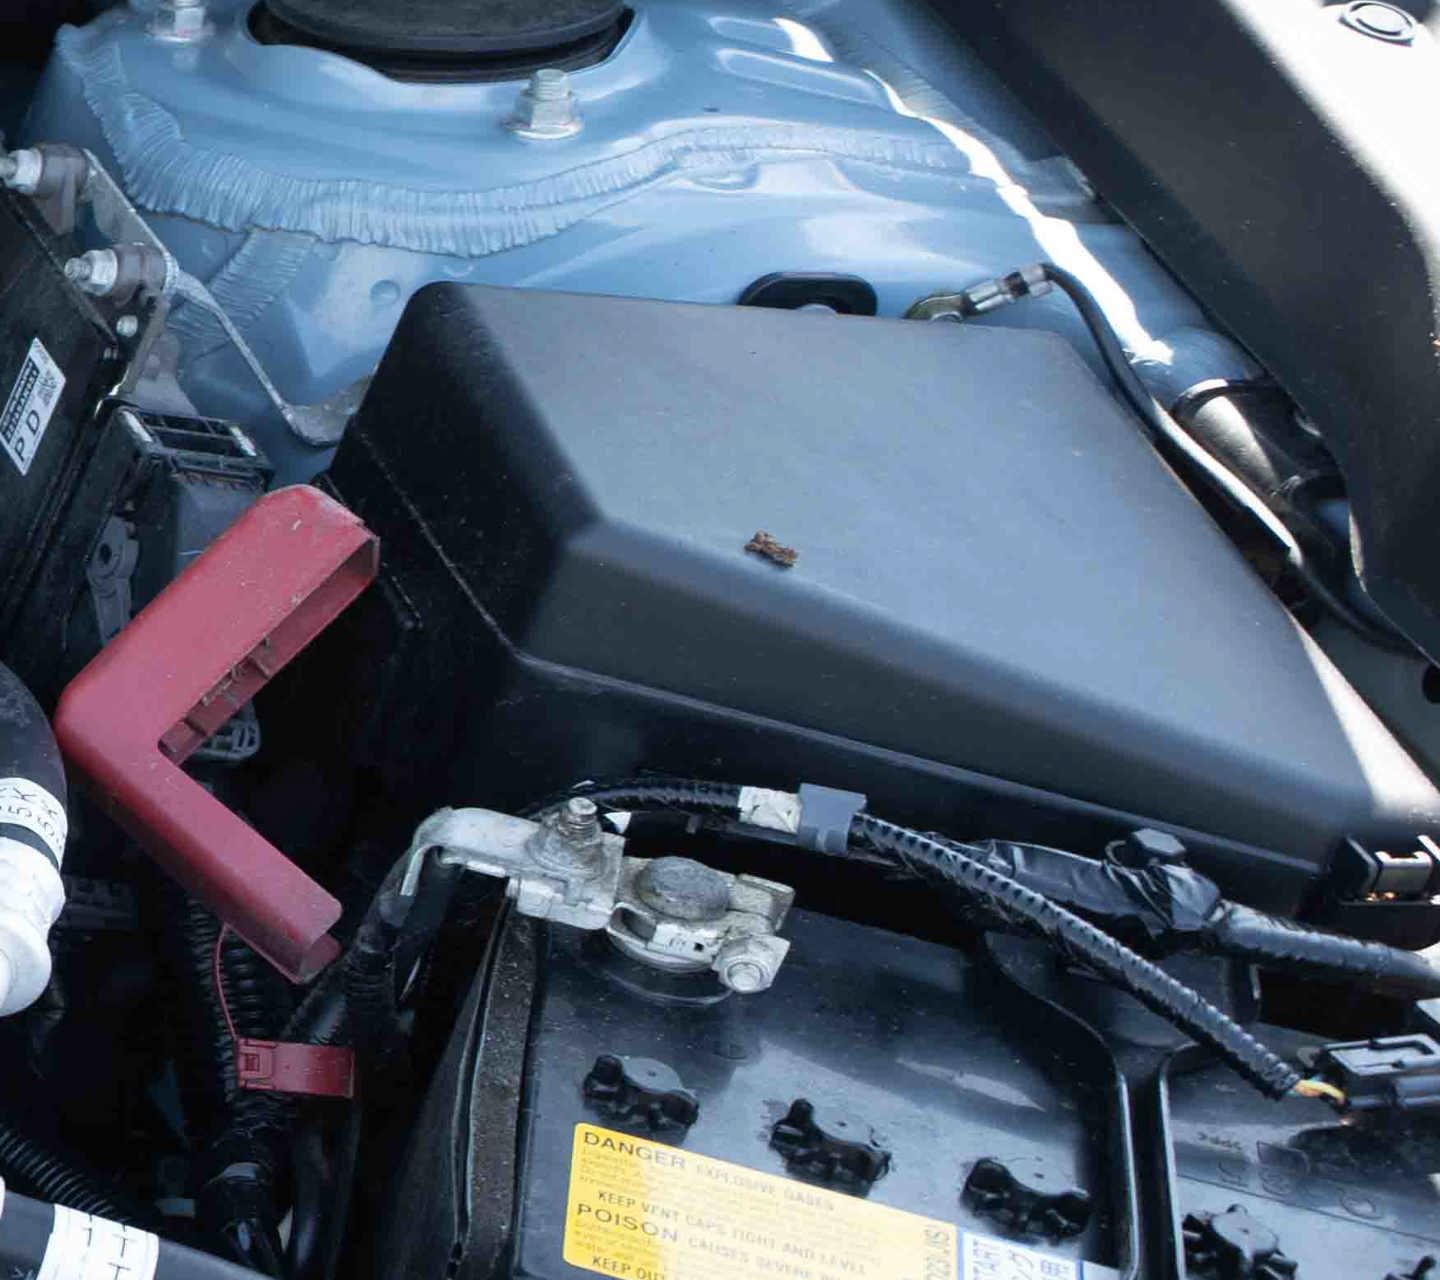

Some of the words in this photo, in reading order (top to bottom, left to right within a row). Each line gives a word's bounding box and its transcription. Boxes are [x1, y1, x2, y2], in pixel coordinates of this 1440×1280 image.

[583, 1131, 686, 1170] DANGER
[695, 1165, 777, 1196] EXPLOSIVE
[783, 1187, 835, 1212] GASES
[576, 1203, 678, 1243] POISON
[688, 1237, 750, 1264] CAUSES
[756, 1256, 812, 1280] SEVERE
[591, 1255, 631, 1275] KEEP
[597, 1190, 636, 1209] KEEP
[641, 1202, 679, 1223] VENT
[685, 1213, 727, 1236] CAPS
[731, 1226, 777, 1250] TIGHT
[782, 1242, 816, 1262] AND
[821, 1251, 867, 1276] LEVEL
